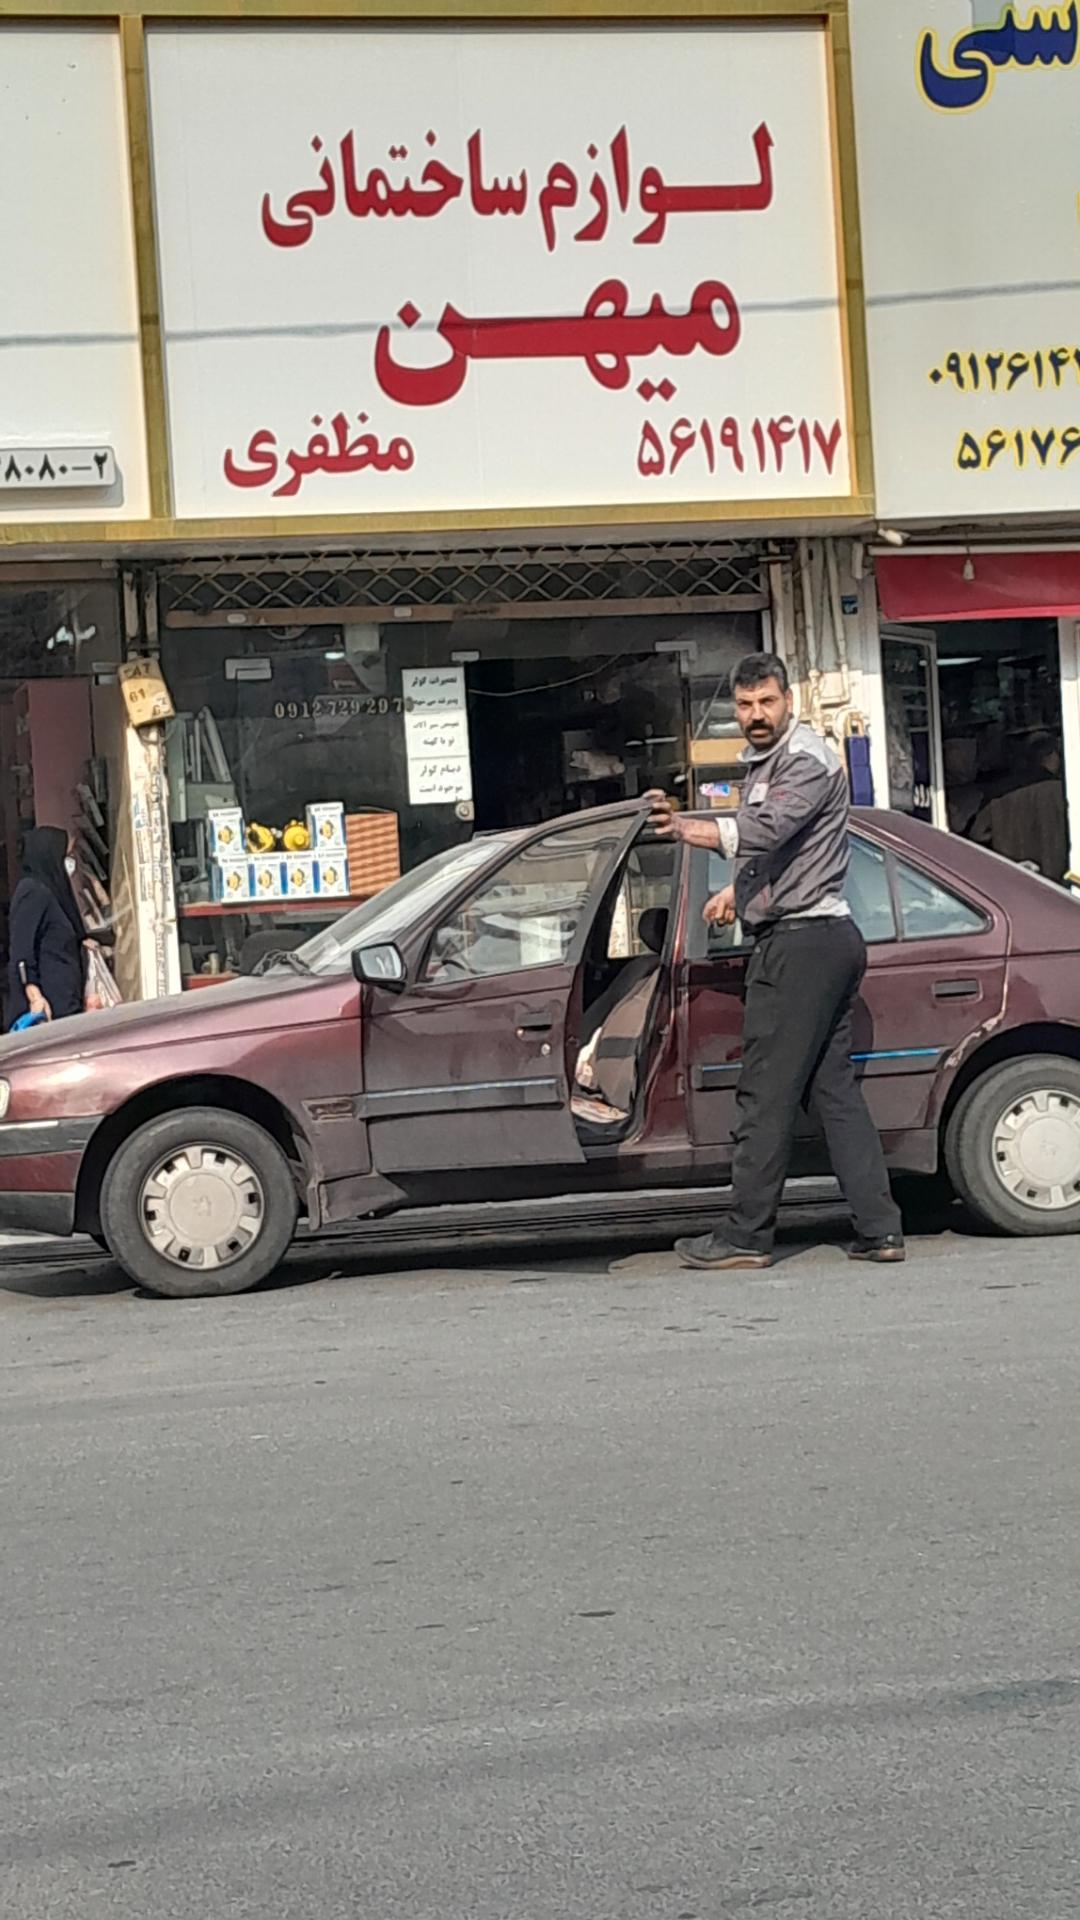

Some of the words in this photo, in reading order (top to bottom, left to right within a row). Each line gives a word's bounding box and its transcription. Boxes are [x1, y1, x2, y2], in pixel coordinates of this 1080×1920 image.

[261, 129, 528, 248] ساختمانی
[538, 121, 774, 252] لوازم
[375, 278, 741, 407] میهن
[223, 411, 415, 498] مظفری
[637, 415, 842, 477] ۵۶۱۹۱۴۱۷
